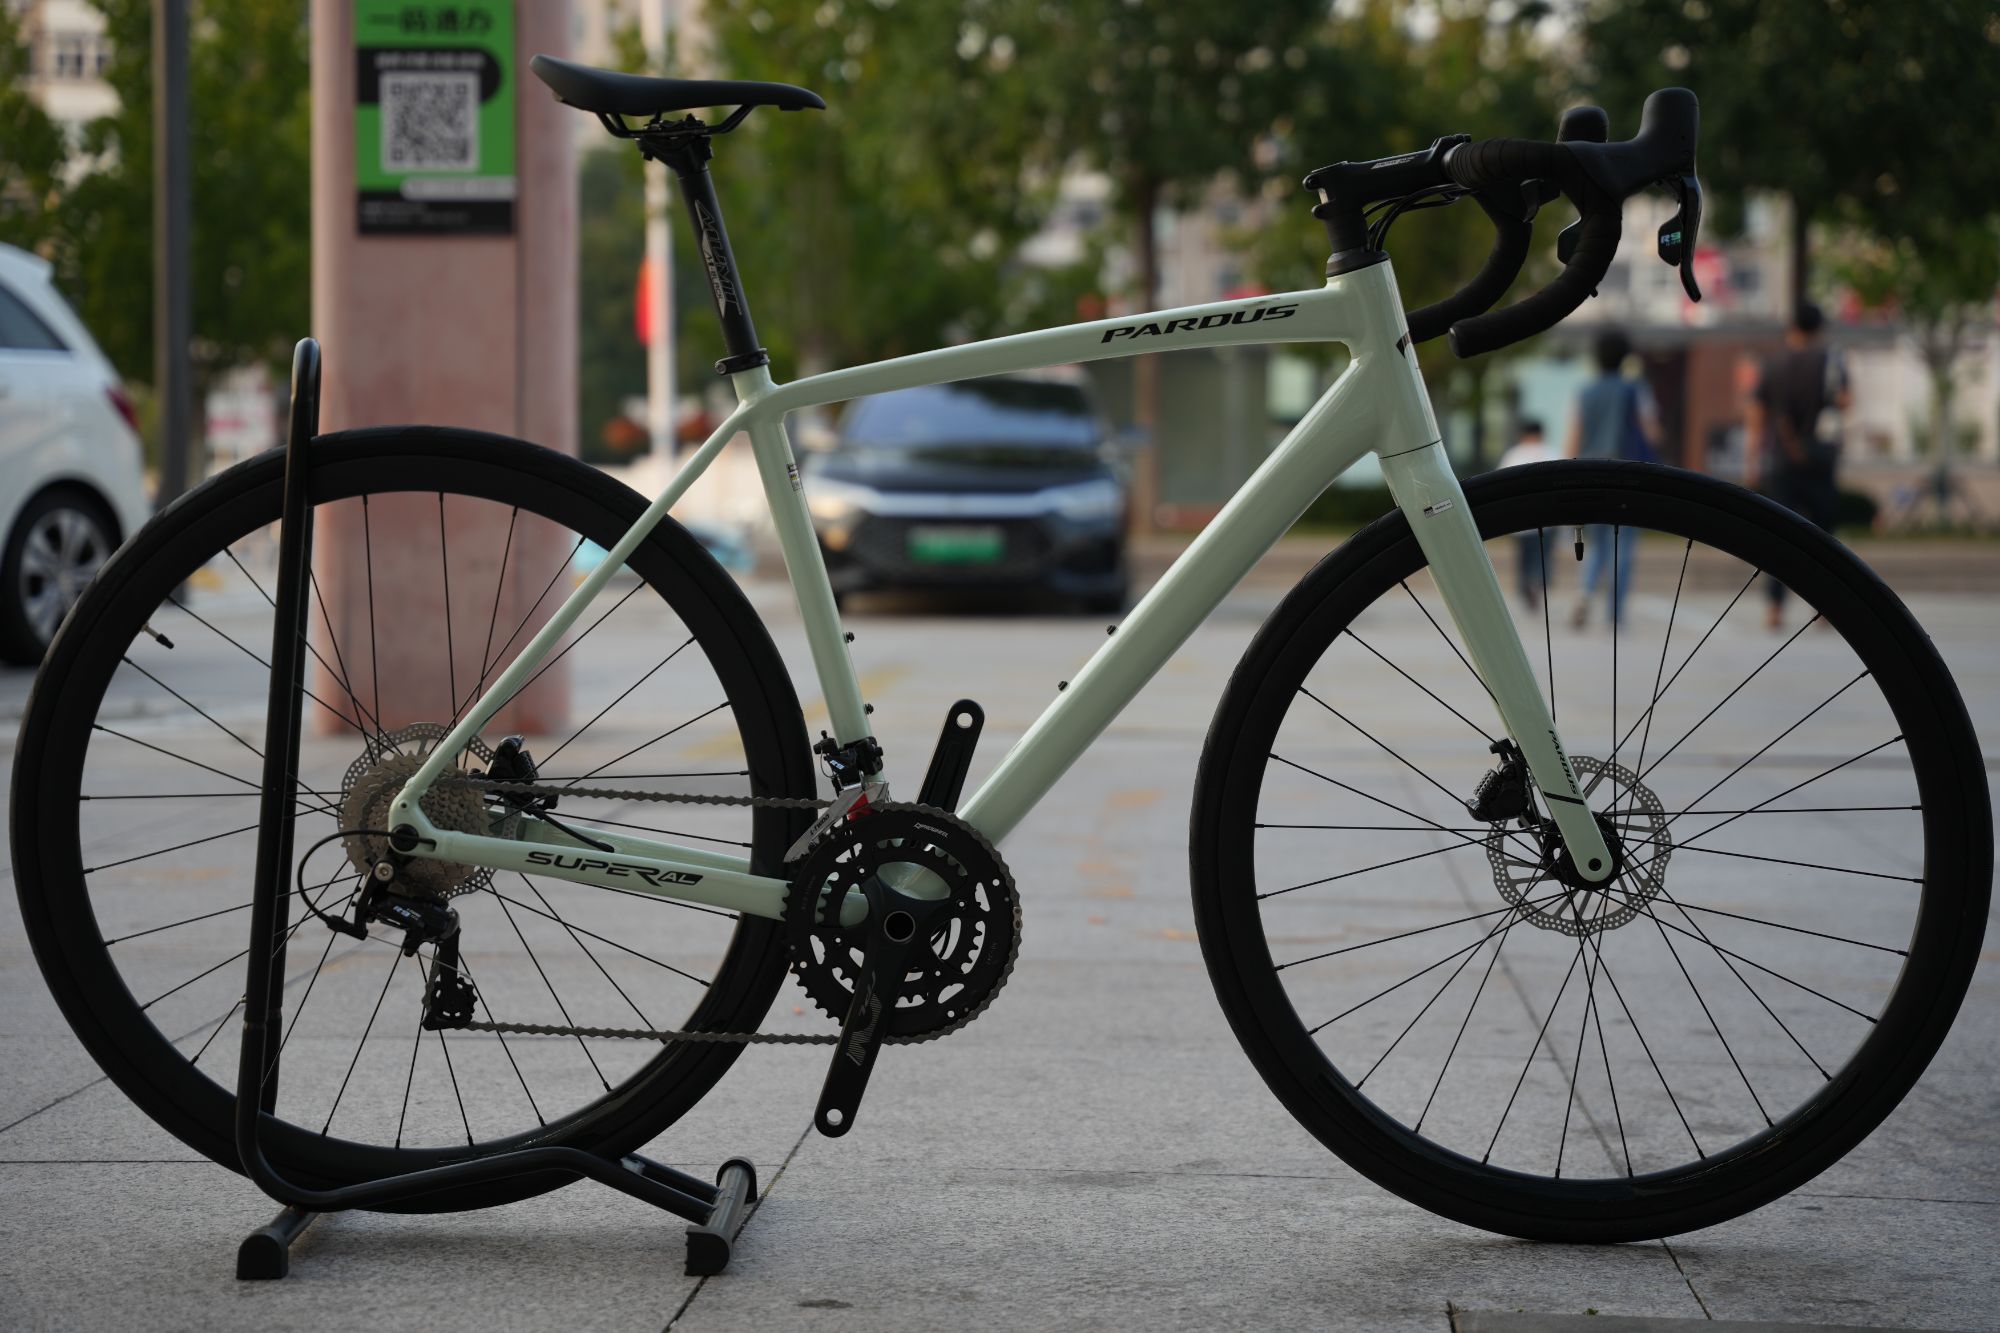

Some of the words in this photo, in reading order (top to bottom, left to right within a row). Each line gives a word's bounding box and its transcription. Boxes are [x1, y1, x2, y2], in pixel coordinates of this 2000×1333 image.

[1101, 303, 1299, 343] PARDUS
[1548, 730, 1579, 795] PARDUS
[525, 851, 663, 887] SUPER
